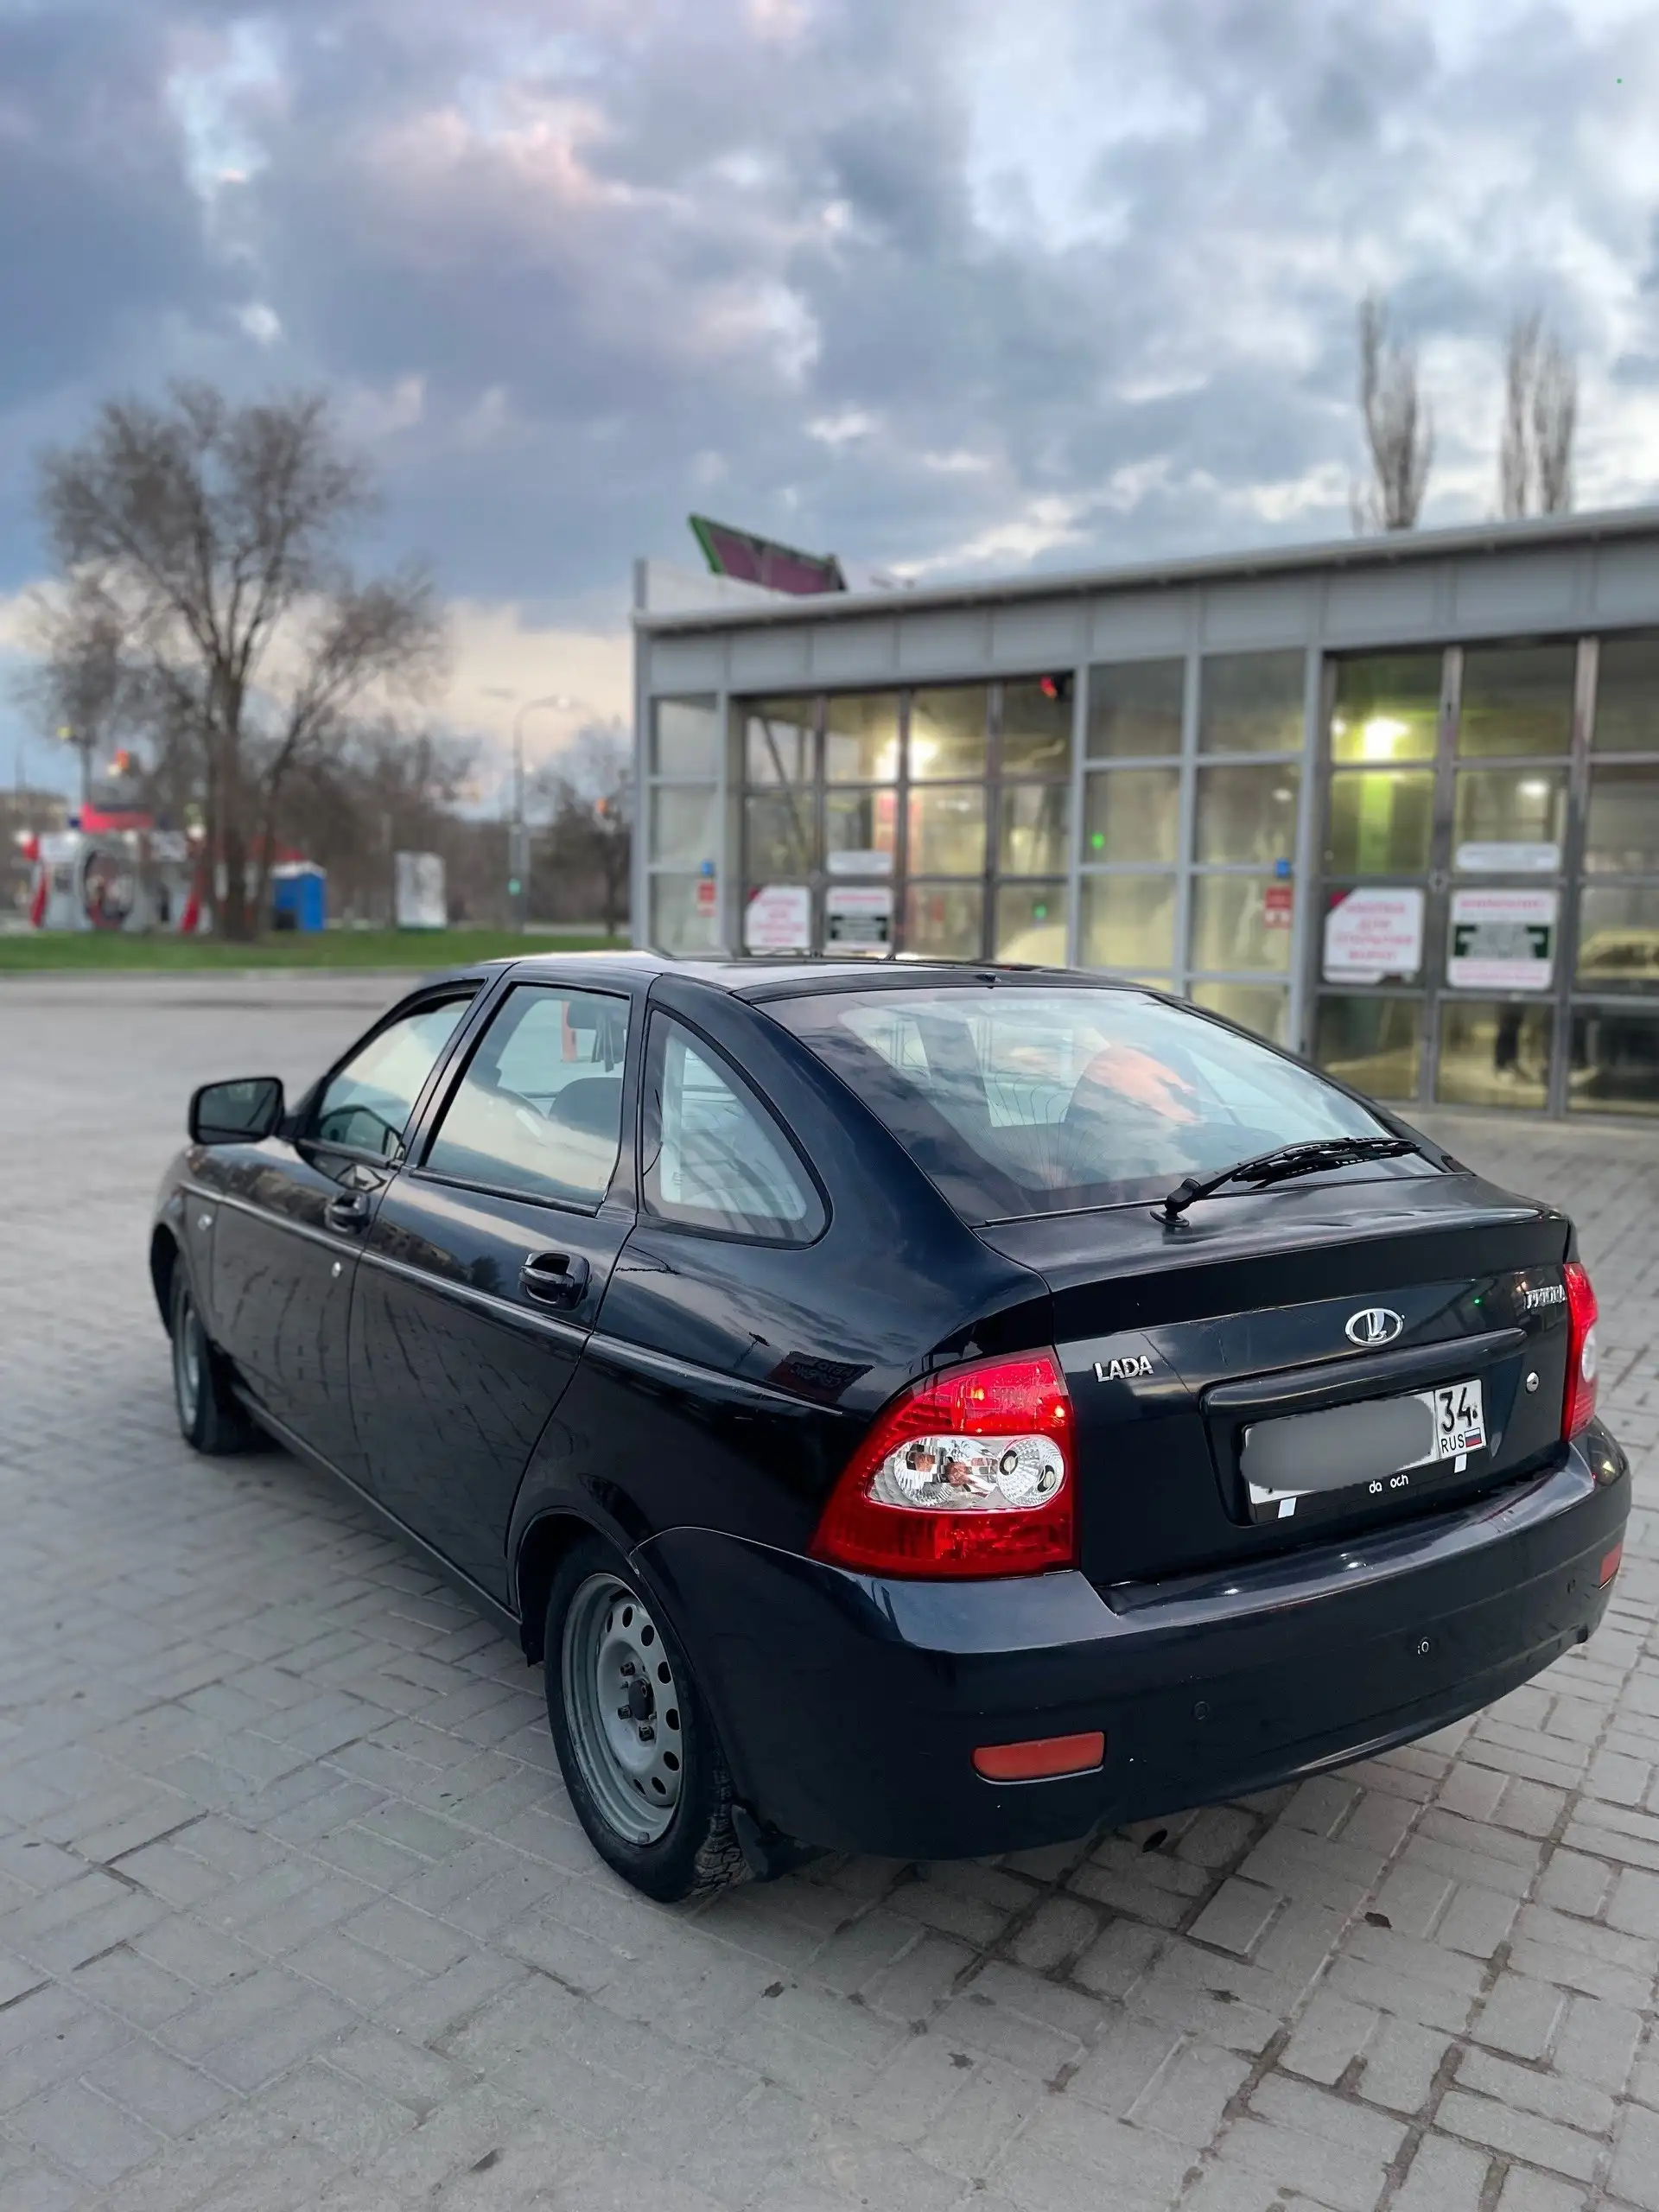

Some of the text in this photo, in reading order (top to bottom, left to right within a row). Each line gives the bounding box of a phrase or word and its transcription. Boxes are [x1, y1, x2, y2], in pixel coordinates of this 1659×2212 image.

[1093, 1355, 1154, 1382] LADA
[1439, 1387, 1472, 1433] 34
[1440, 1433, 1465, 1453] RUS
[1389, 1474, 1409, 1488] och
